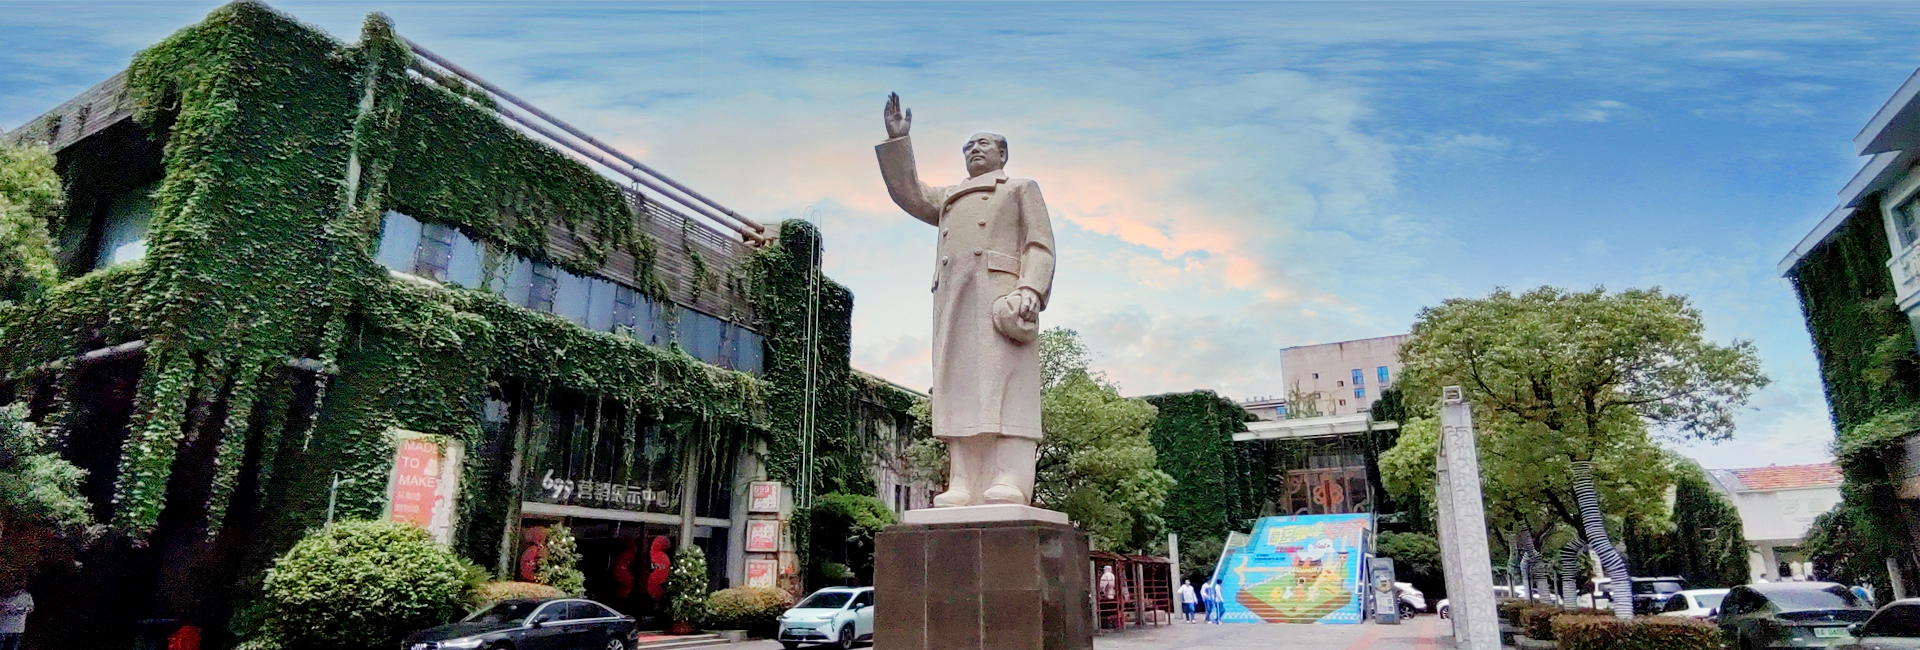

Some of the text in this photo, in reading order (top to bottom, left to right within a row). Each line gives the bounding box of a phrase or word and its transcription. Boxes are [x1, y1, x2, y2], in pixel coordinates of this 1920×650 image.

[403, 457, 420, 468] TO
[399, 475, 436, 488] MAKE
[541, 468, 575, 500] 699
[754, 485, 770, 493] 699
